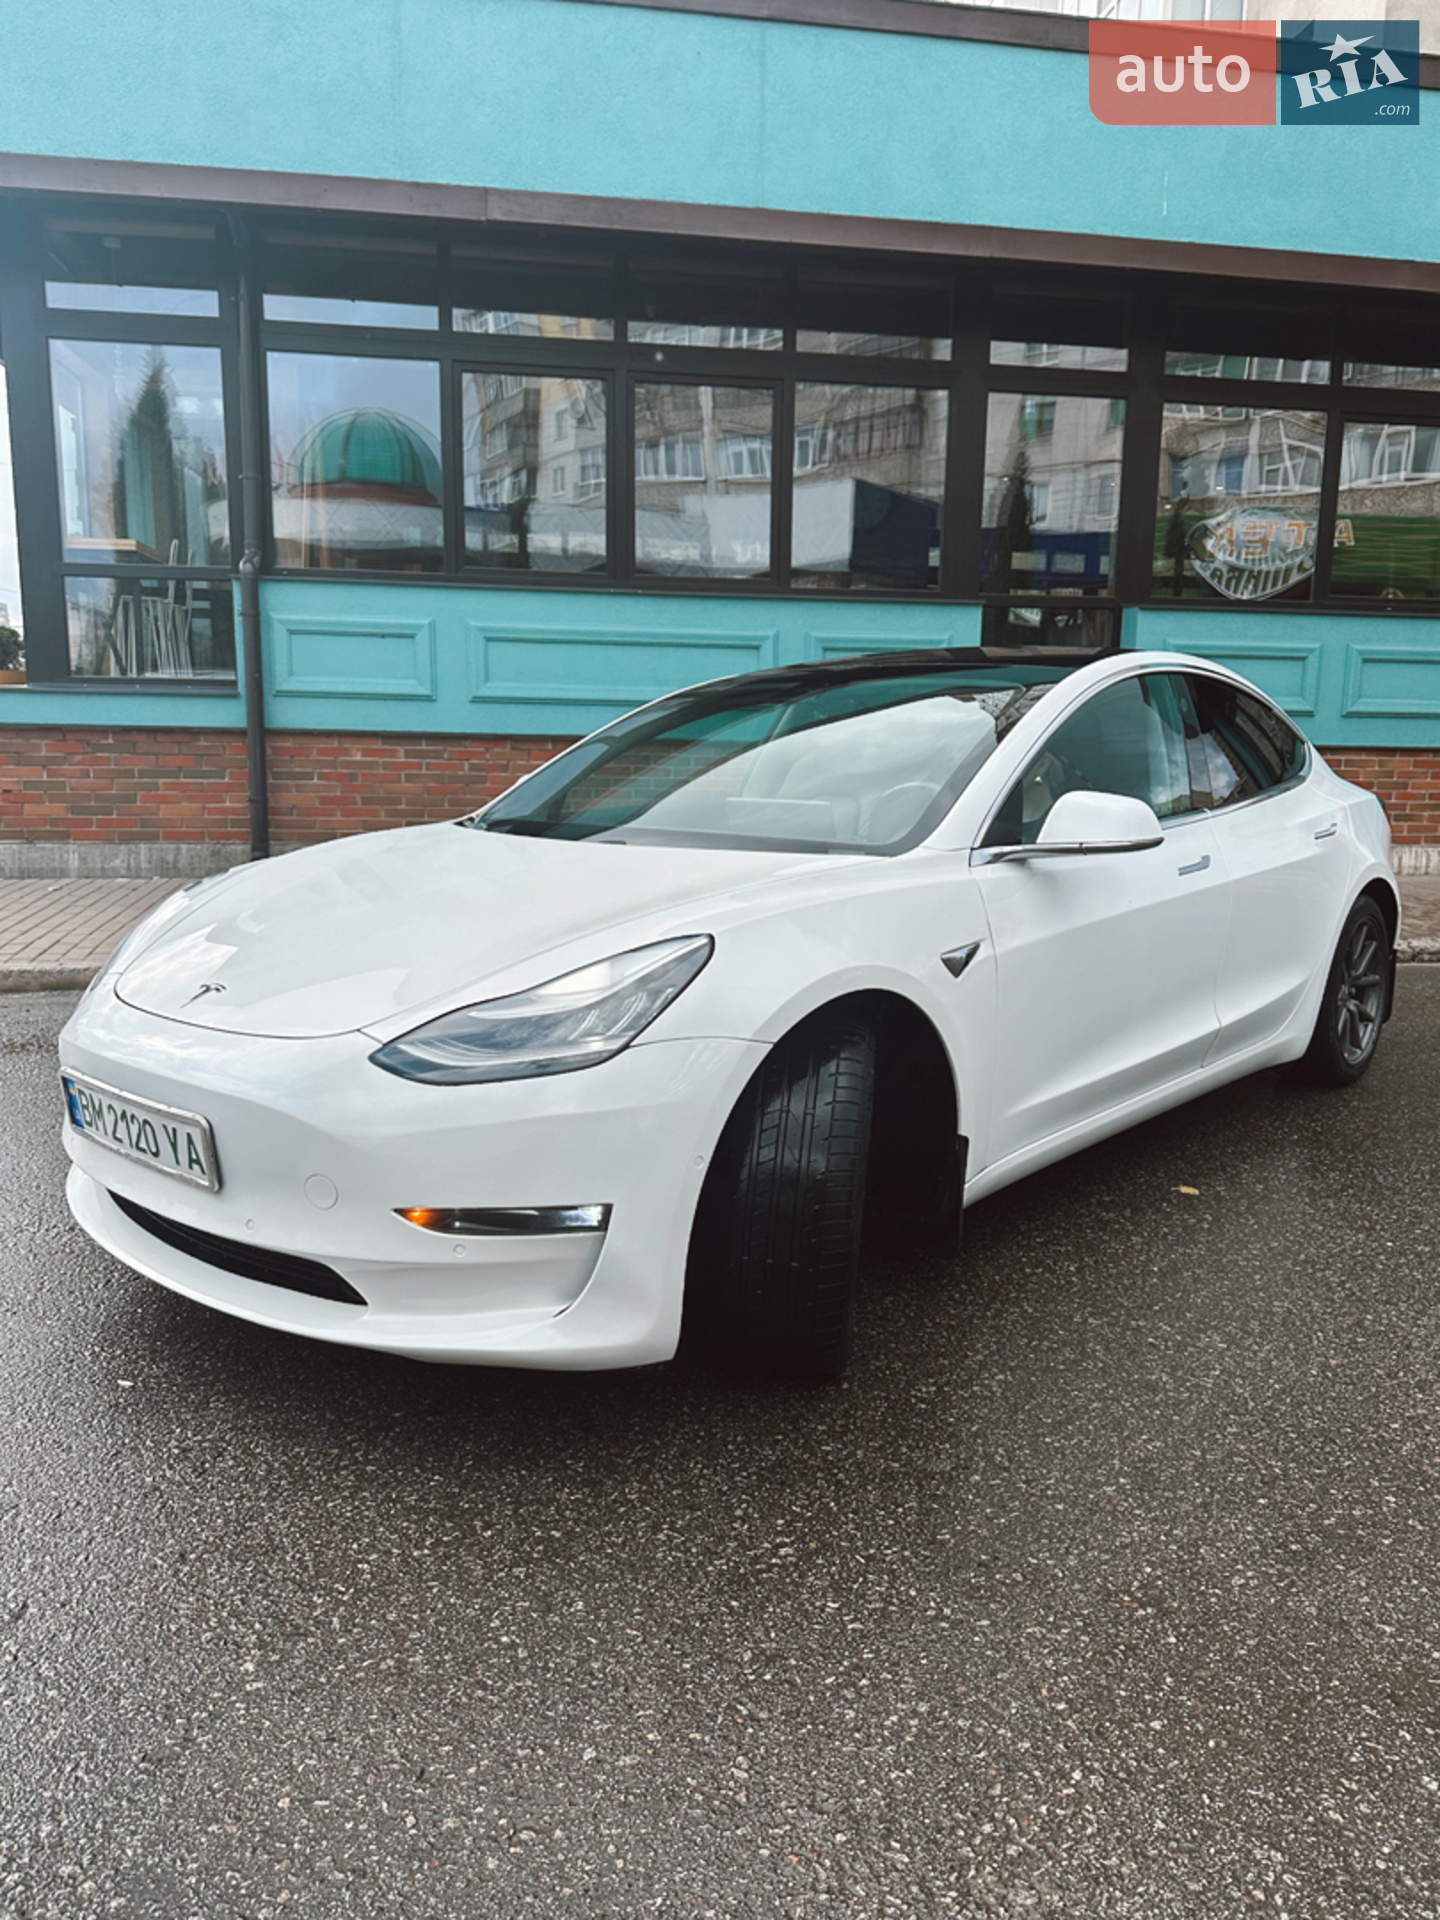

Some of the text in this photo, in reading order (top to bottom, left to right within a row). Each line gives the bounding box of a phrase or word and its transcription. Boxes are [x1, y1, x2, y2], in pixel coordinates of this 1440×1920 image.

[78, 1088, 206, 1175] BM 2120 YA
